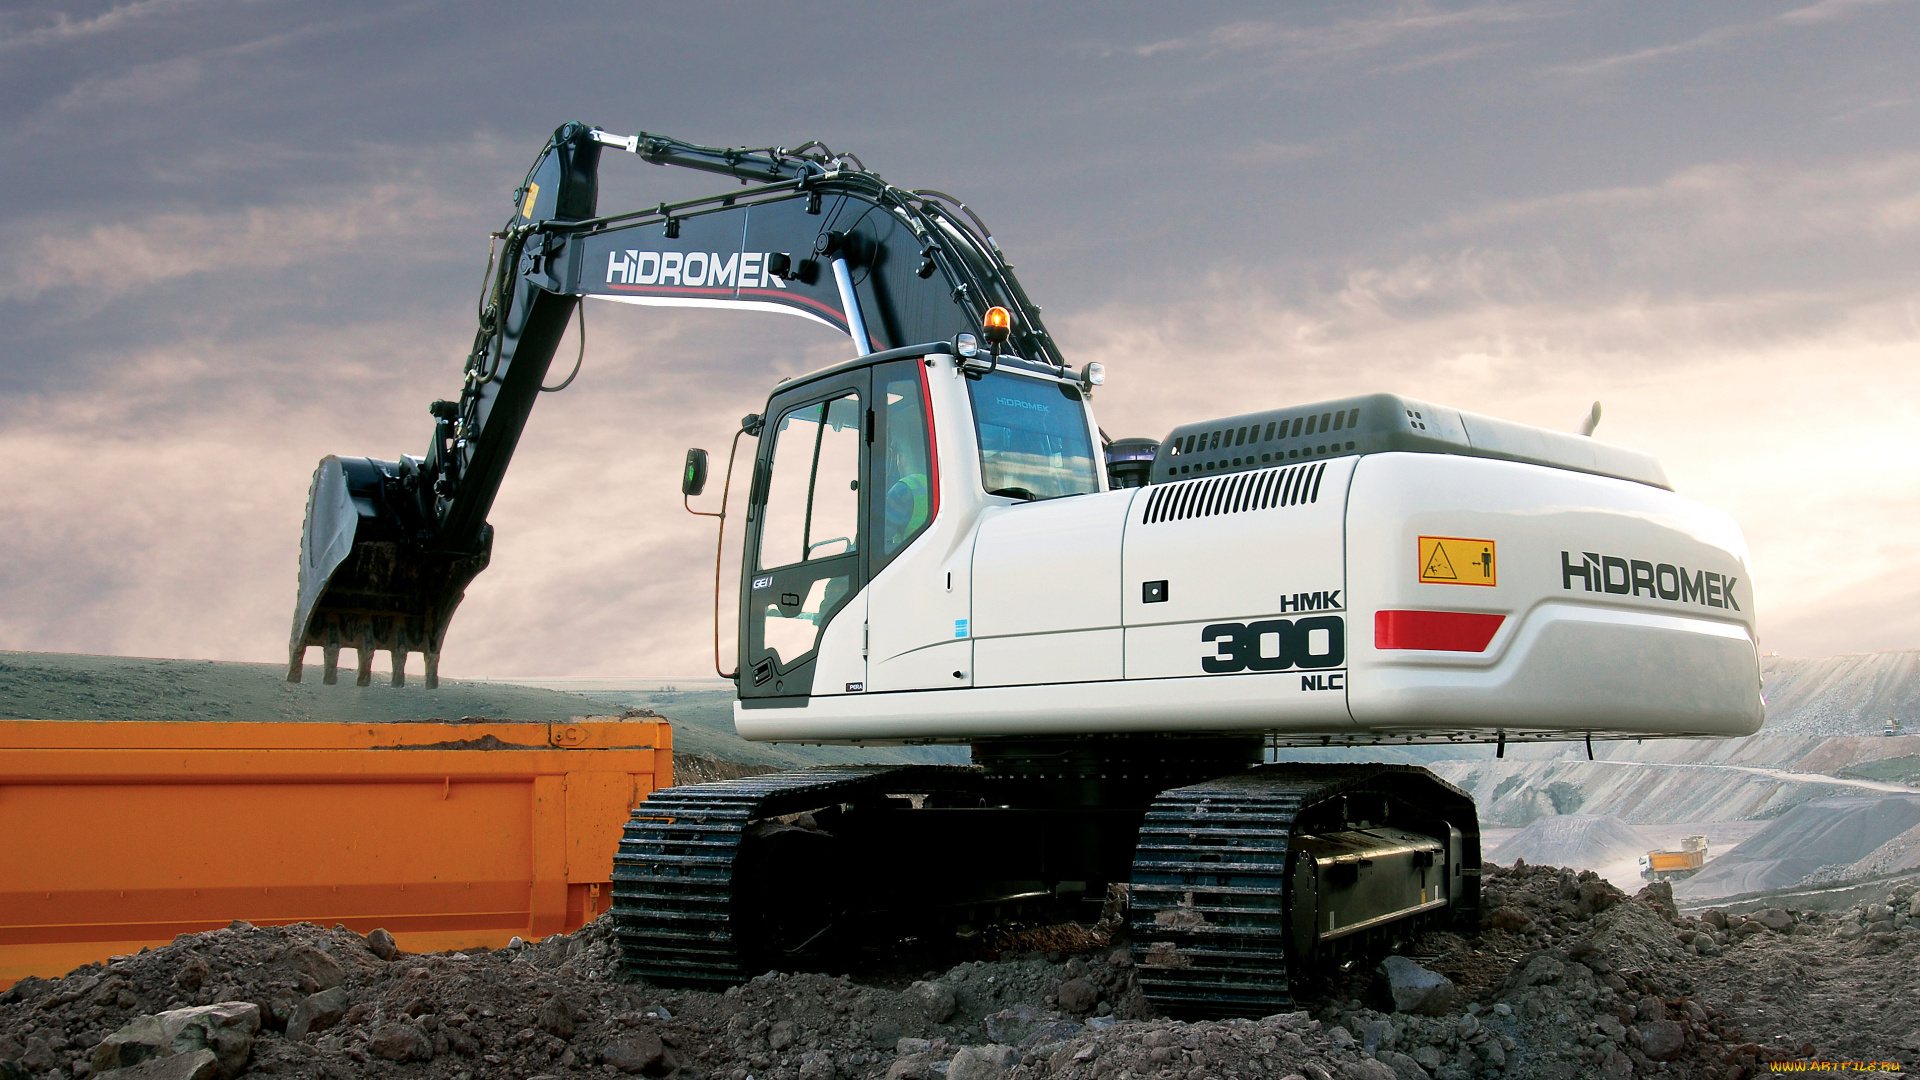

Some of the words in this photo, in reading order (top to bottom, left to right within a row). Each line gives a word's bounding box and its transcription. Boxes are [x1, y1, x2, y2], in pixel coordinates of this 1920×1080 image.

[1280, 590, 1342, 612] HMK
[1202, 615, 1345, 673] 300
[1301, 674, 1344, 691] NLC
